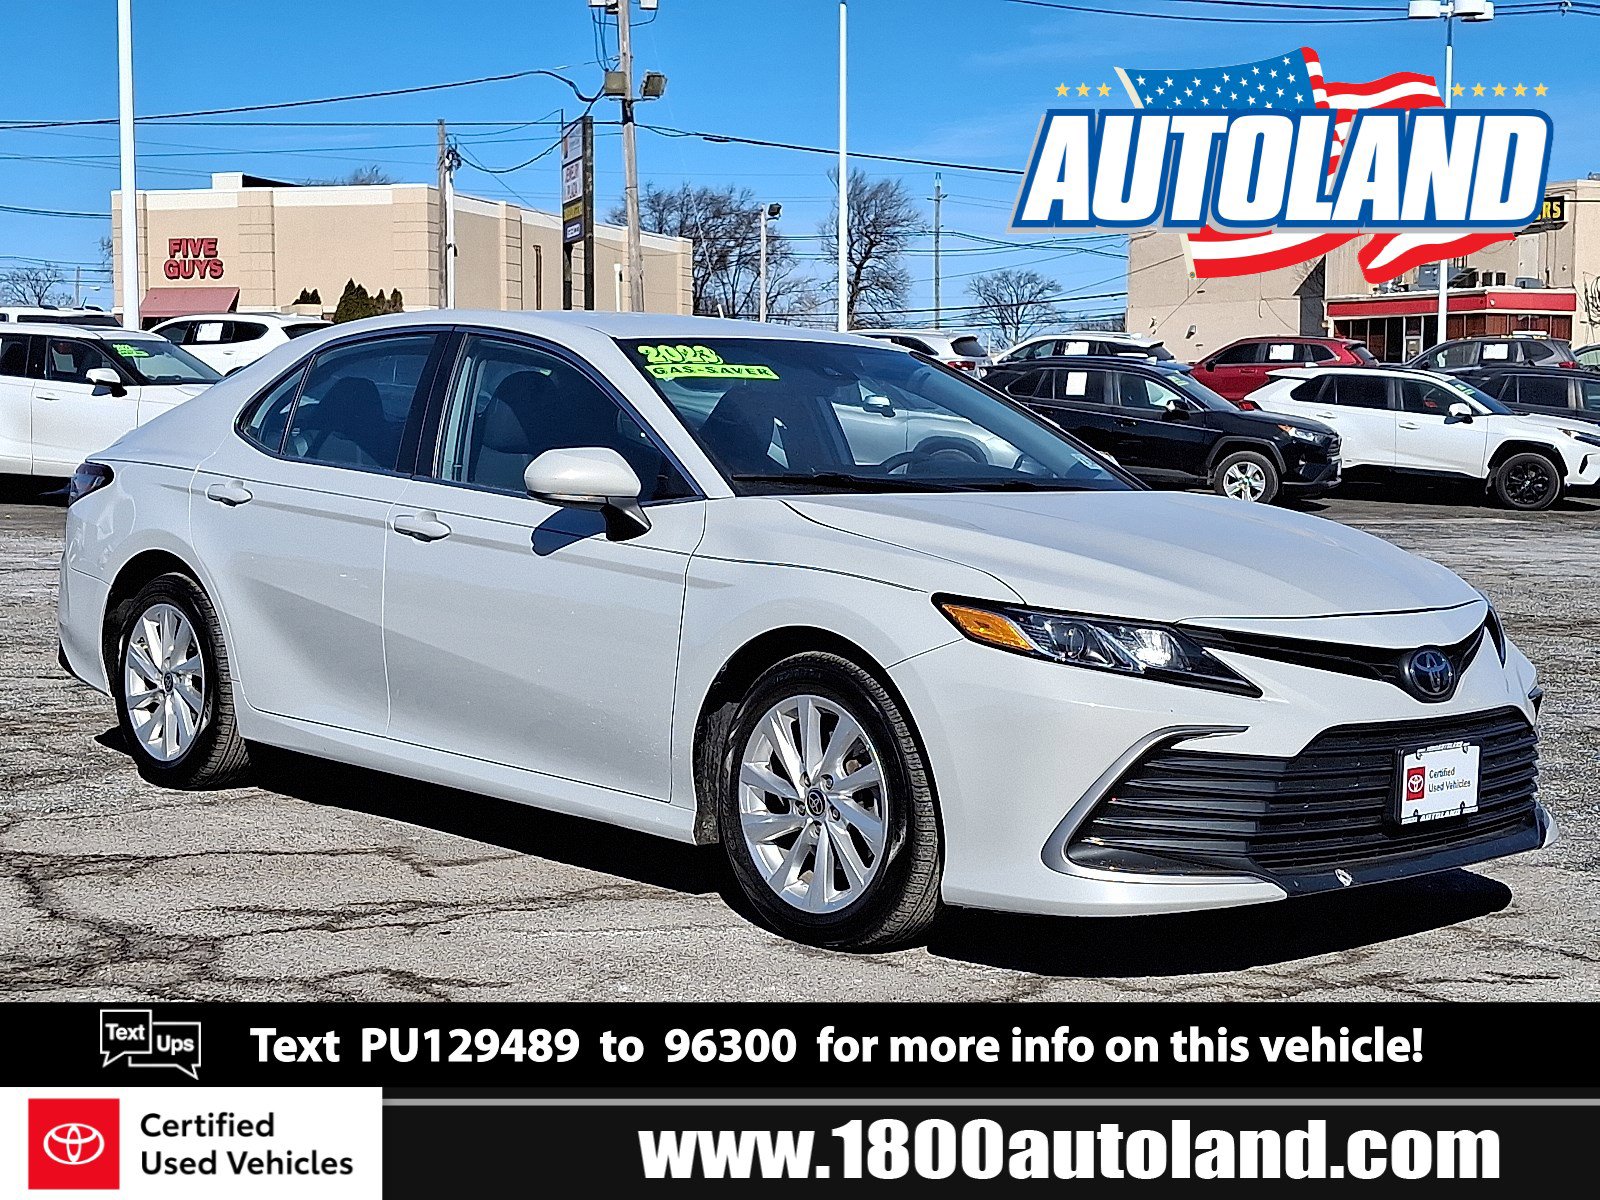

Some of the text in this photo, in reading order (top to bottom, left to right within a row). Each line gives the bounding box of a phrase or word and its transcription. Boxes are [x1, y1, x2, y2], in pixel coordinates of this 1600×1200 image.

[168, 238, 218, 258] FIVE
[164, 259, 224, 279] GUYS
[637, 344, 724, 365] 2023
[652, 366, 773, 376] GAS-SAVER
[1429, 767, 1456, 778] Certified
[1429, 782, 1445, 792] Used
[1446, 780, 1471, 790] Vehicles
